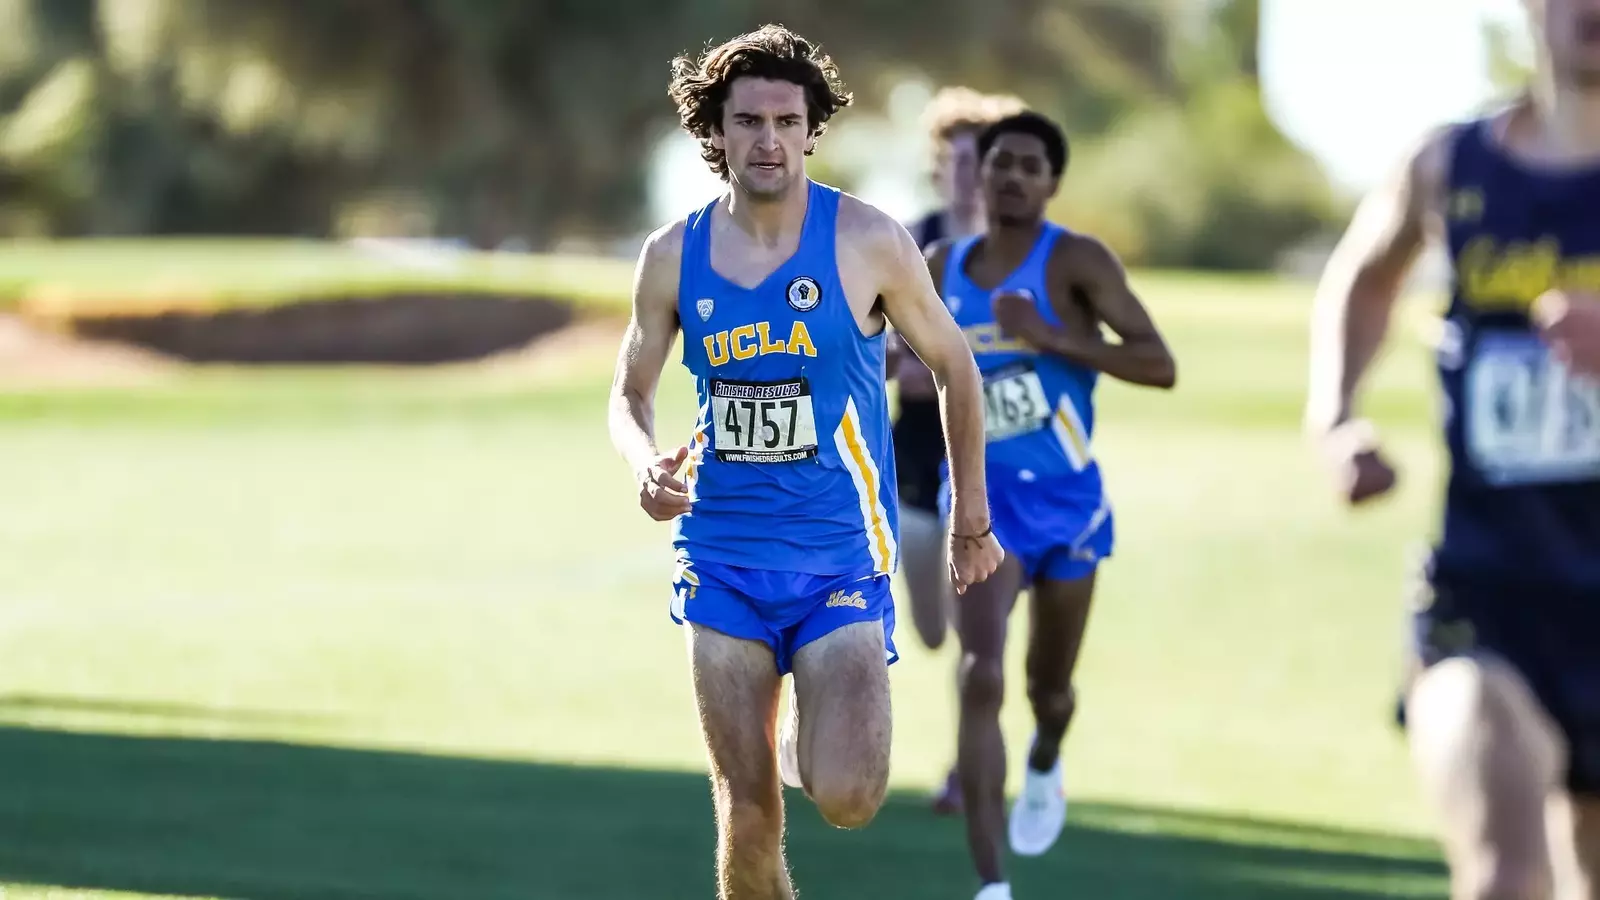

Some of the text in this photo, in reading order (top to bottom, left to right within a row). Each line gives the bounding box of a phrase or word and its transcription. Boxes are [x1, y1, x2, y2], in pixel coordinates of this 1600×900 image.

[703, 320, 818, 367] UCLA
[715, 381, 801, 398] FINISHED RESULTS
[725, 400, 798, 448] 4757
[725, 451, 808, 463] WWW.FINISHEDRESULTS.COM
